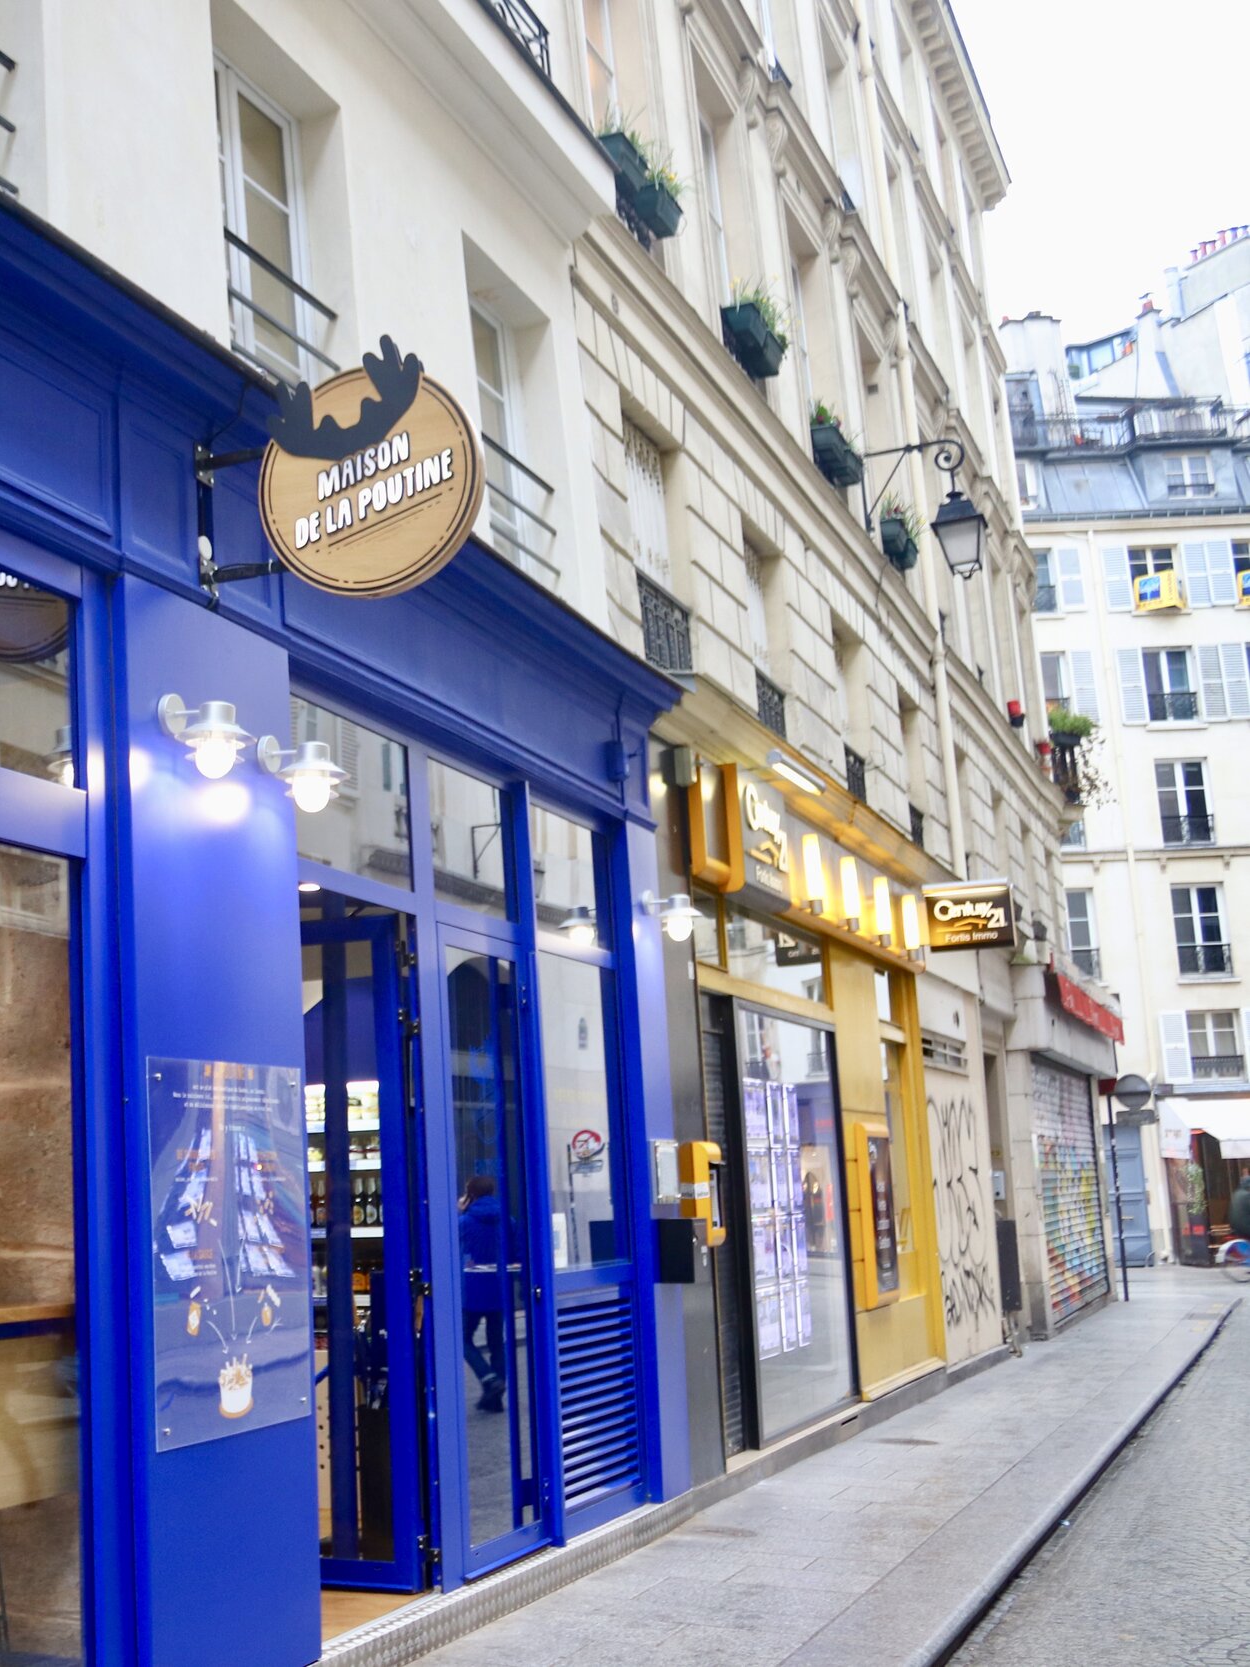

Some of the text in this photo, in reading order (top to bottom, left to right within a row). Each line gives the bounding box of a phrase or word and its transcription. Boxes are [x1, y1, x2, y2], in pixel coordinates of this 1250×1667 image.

[316, 431, 411, 502] MAISON
[294, 448, 454, 550] DE LA POUTINE
[933, 899, 1007, 929] Century 21
[945, 931, 999, 943] Fortis Immo
